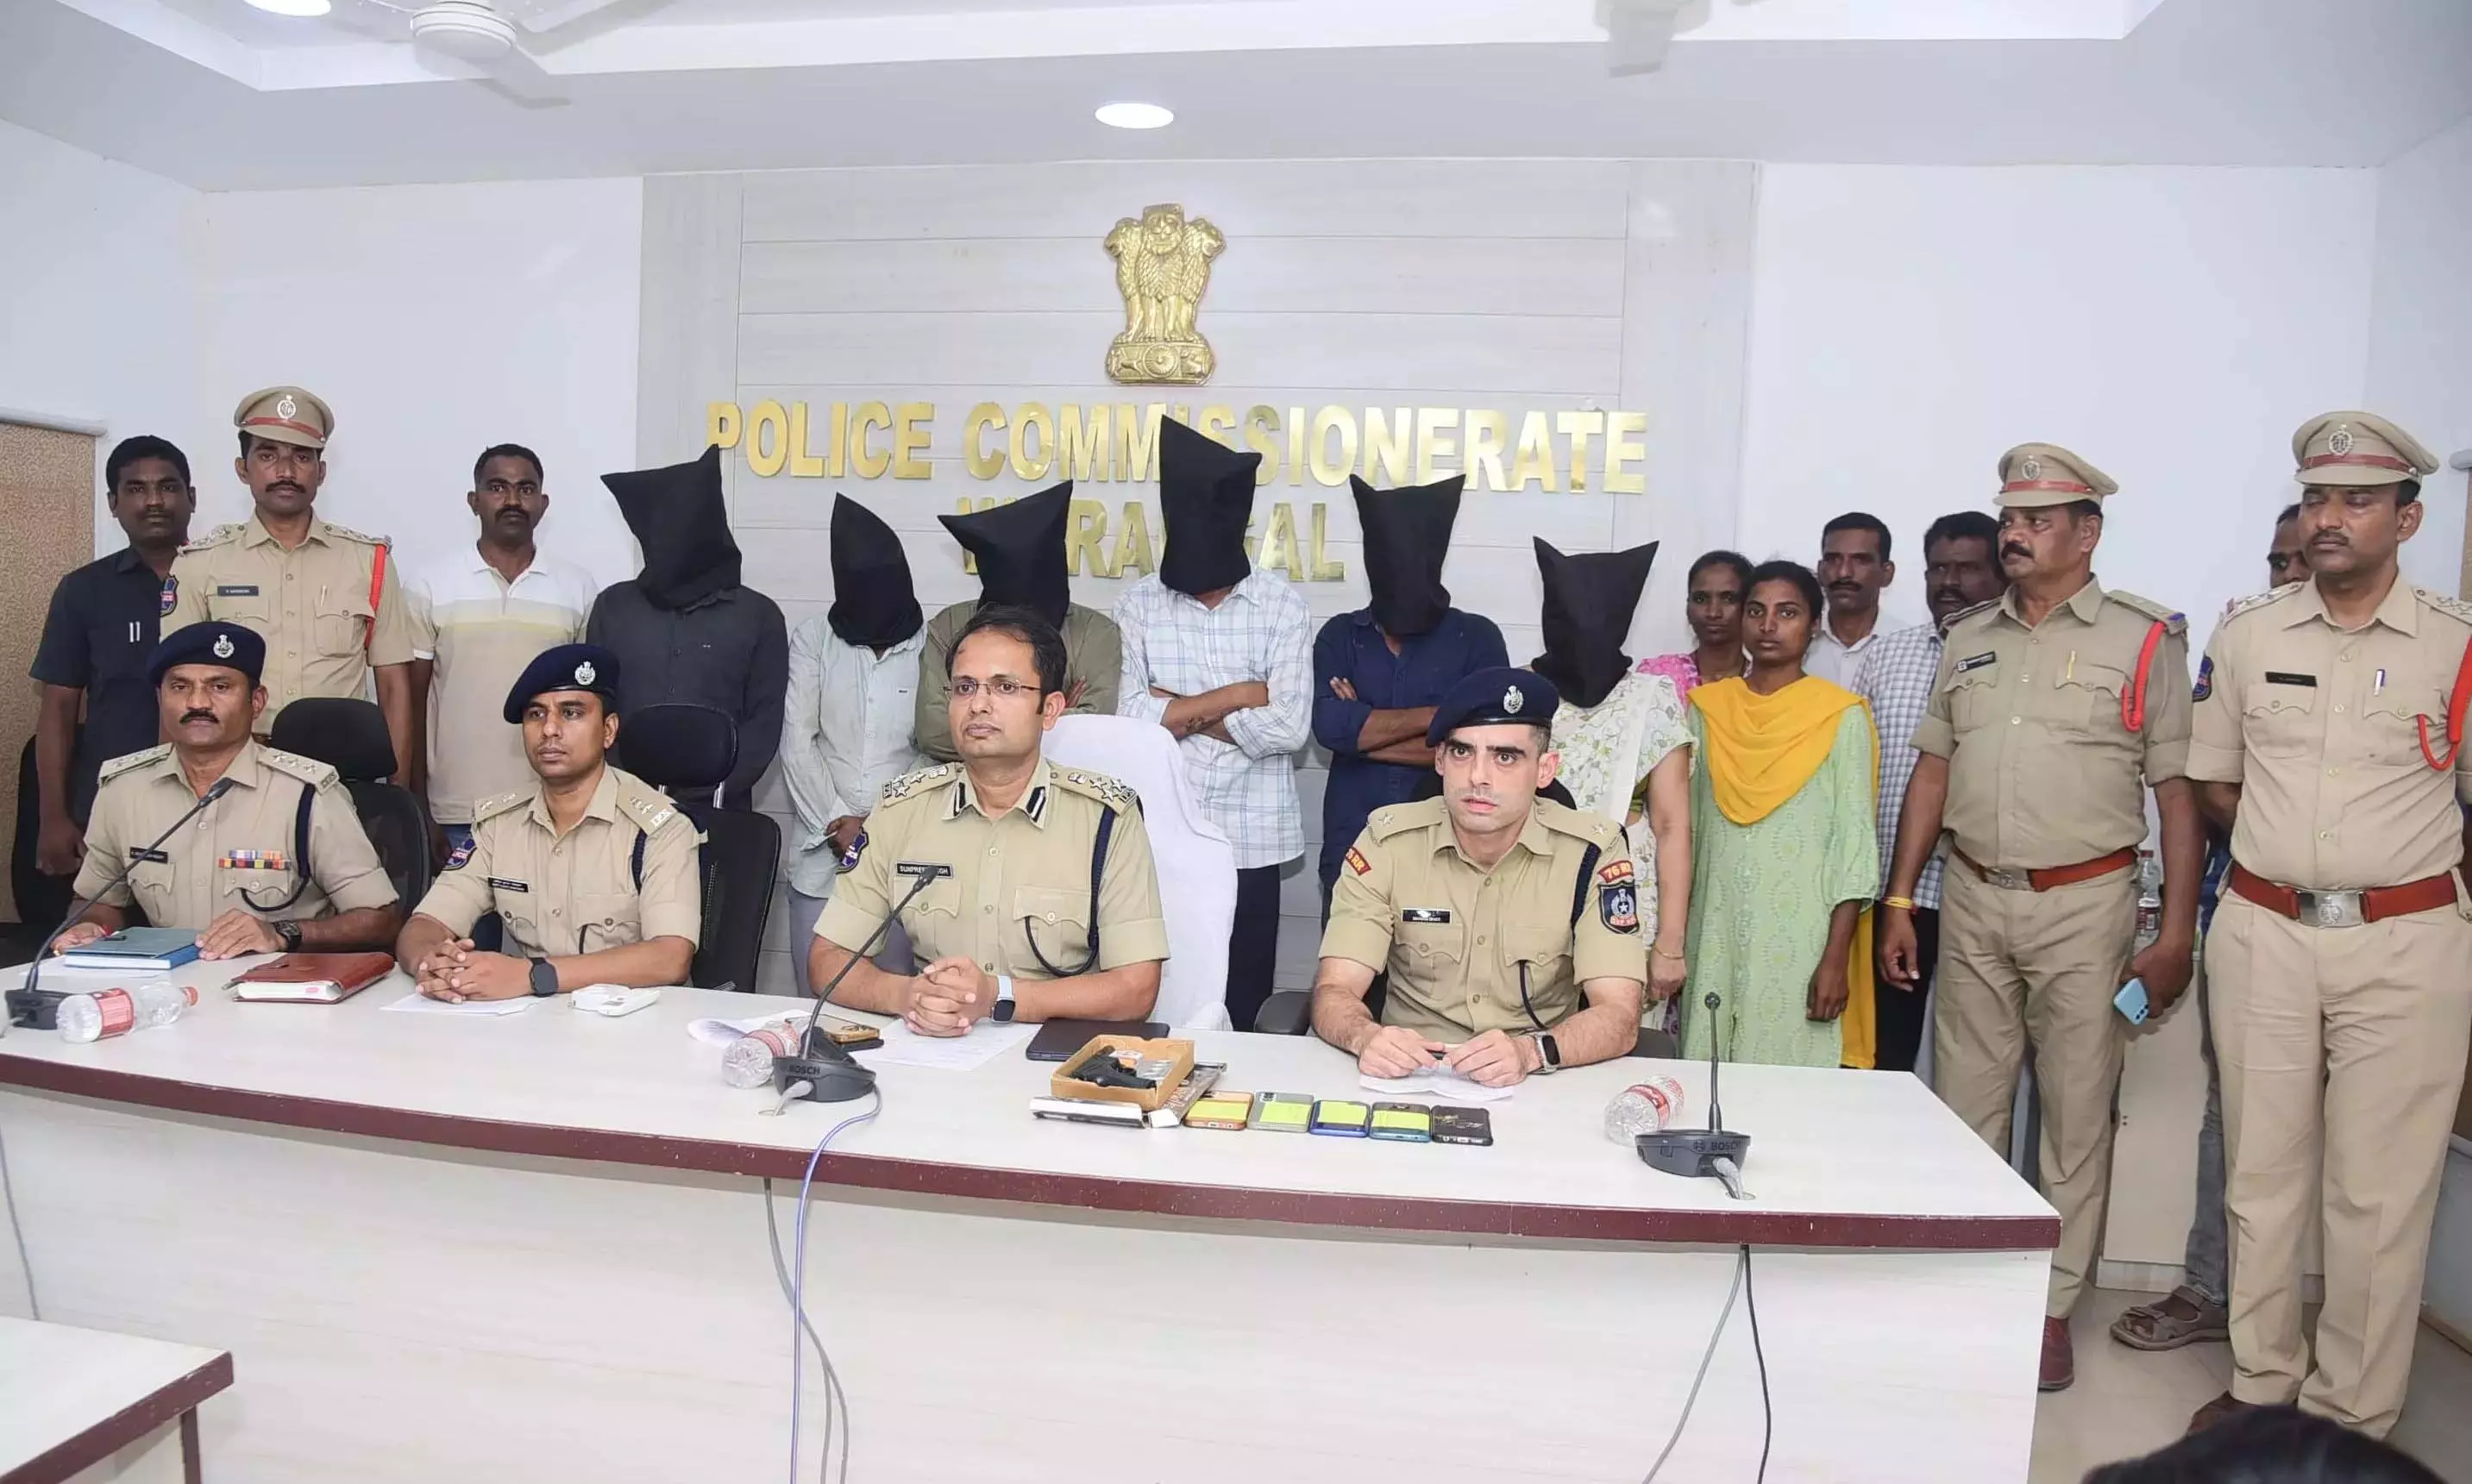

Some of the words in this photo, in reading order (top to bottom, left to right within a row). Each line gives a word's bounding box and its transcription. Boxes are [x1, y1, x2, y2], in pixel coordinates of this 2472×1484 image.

[706, 399, 934, 479] POLICE
[963, 402, 1647, 494] COMMSSIONERATE
[956, 497, 1346, 583] RAAL
